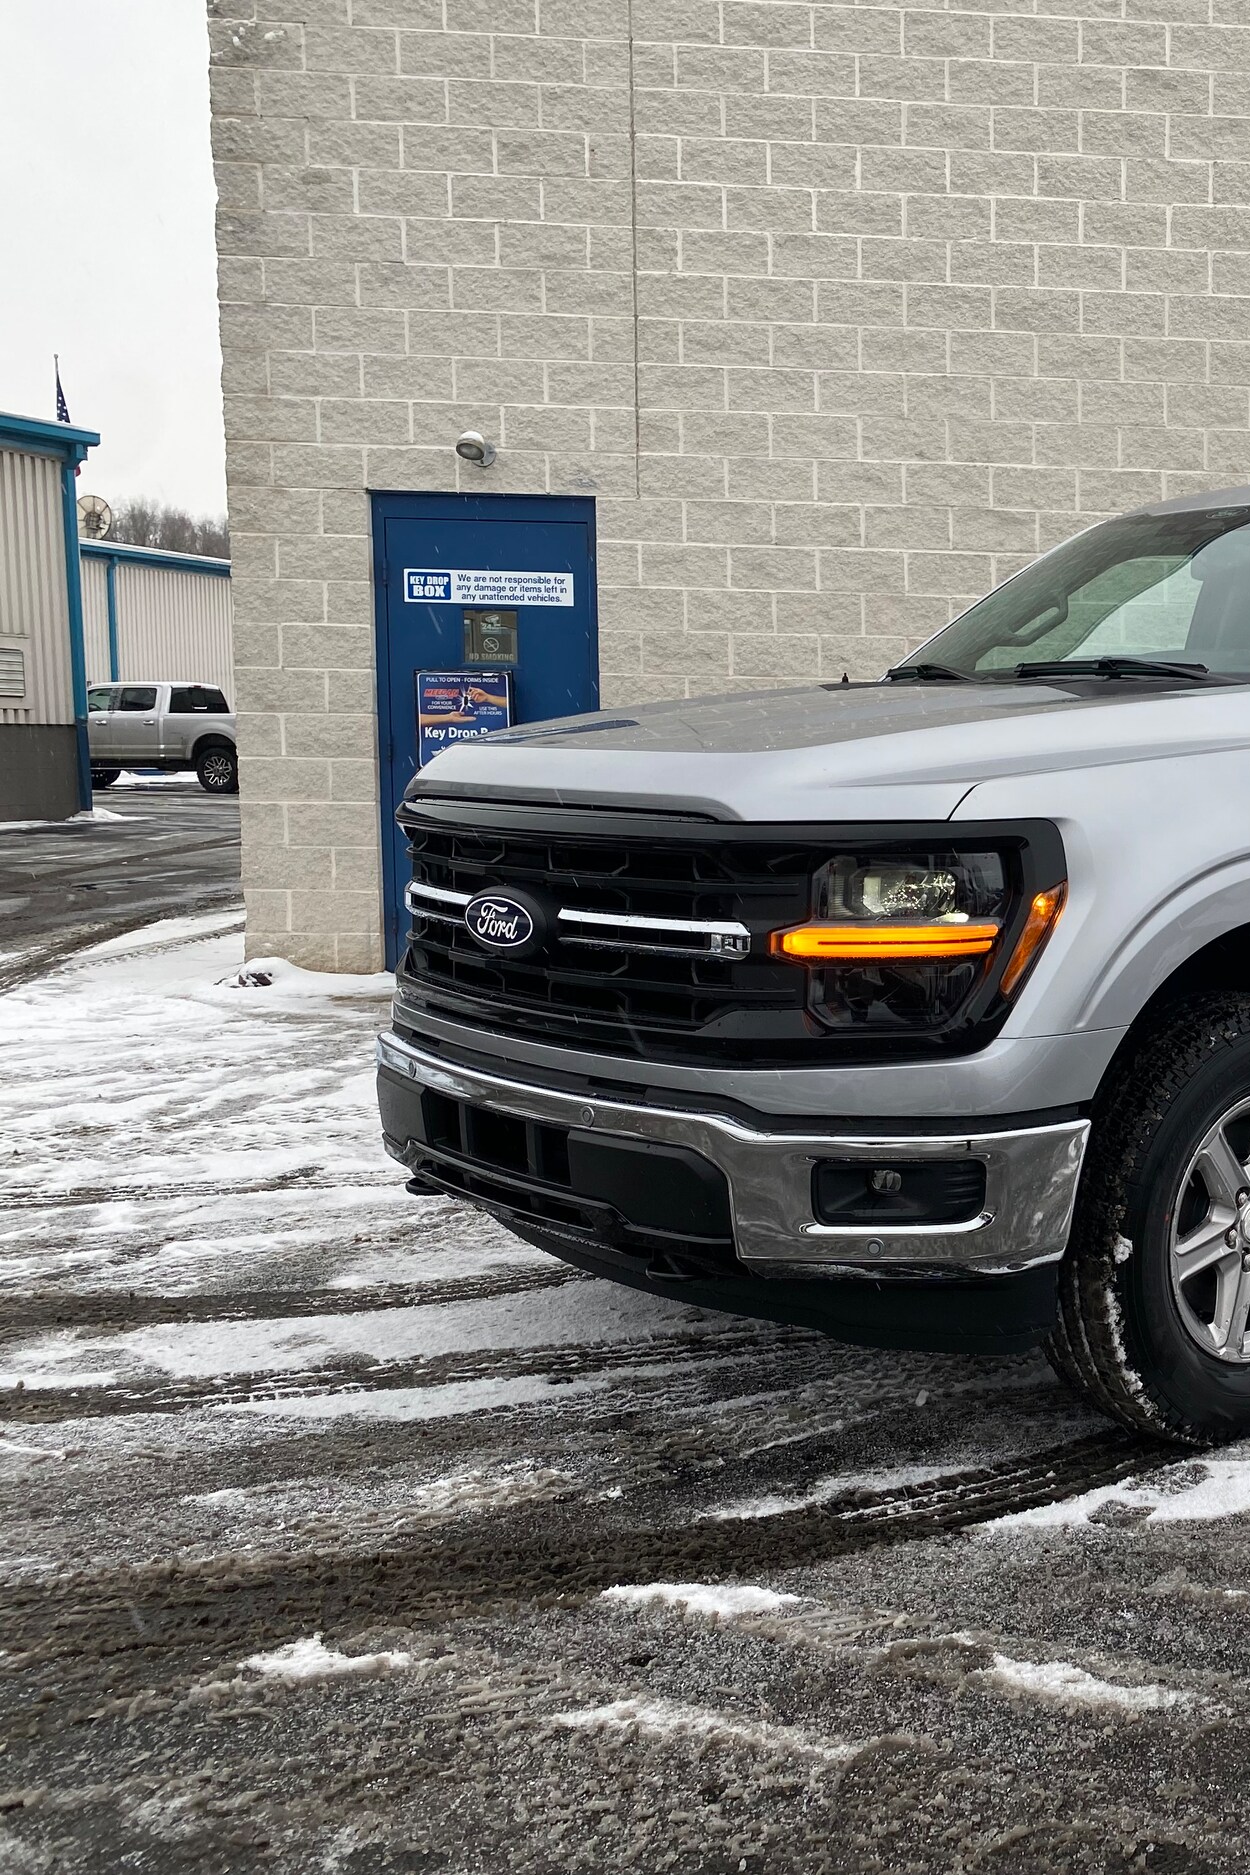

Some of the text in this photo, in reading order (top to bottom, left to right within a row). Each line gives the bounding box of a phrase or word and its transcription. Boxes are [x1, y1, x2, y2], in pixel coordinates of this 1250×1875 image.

[410, 576, 449, 585] KEY DROP
[457, 574, 471, 582] We
[504, 576, 551, 585] responsible
[554, 577, 566, 585] for
[413, 585, 445, 597] BOX
[456, 584, 471, 592] any
[474, 584, 506, 593] damage
[519, 585, 542, 593] items
[544, 585, 558, 593] left
[559, 586, 567, 594] in
[461, 593, 562, 602] any unattended vehicles.
[481, 653, 514, 661] SMOKING
[425, 727, 446, 741] Key
[476, 902, 518, 940] Ford
